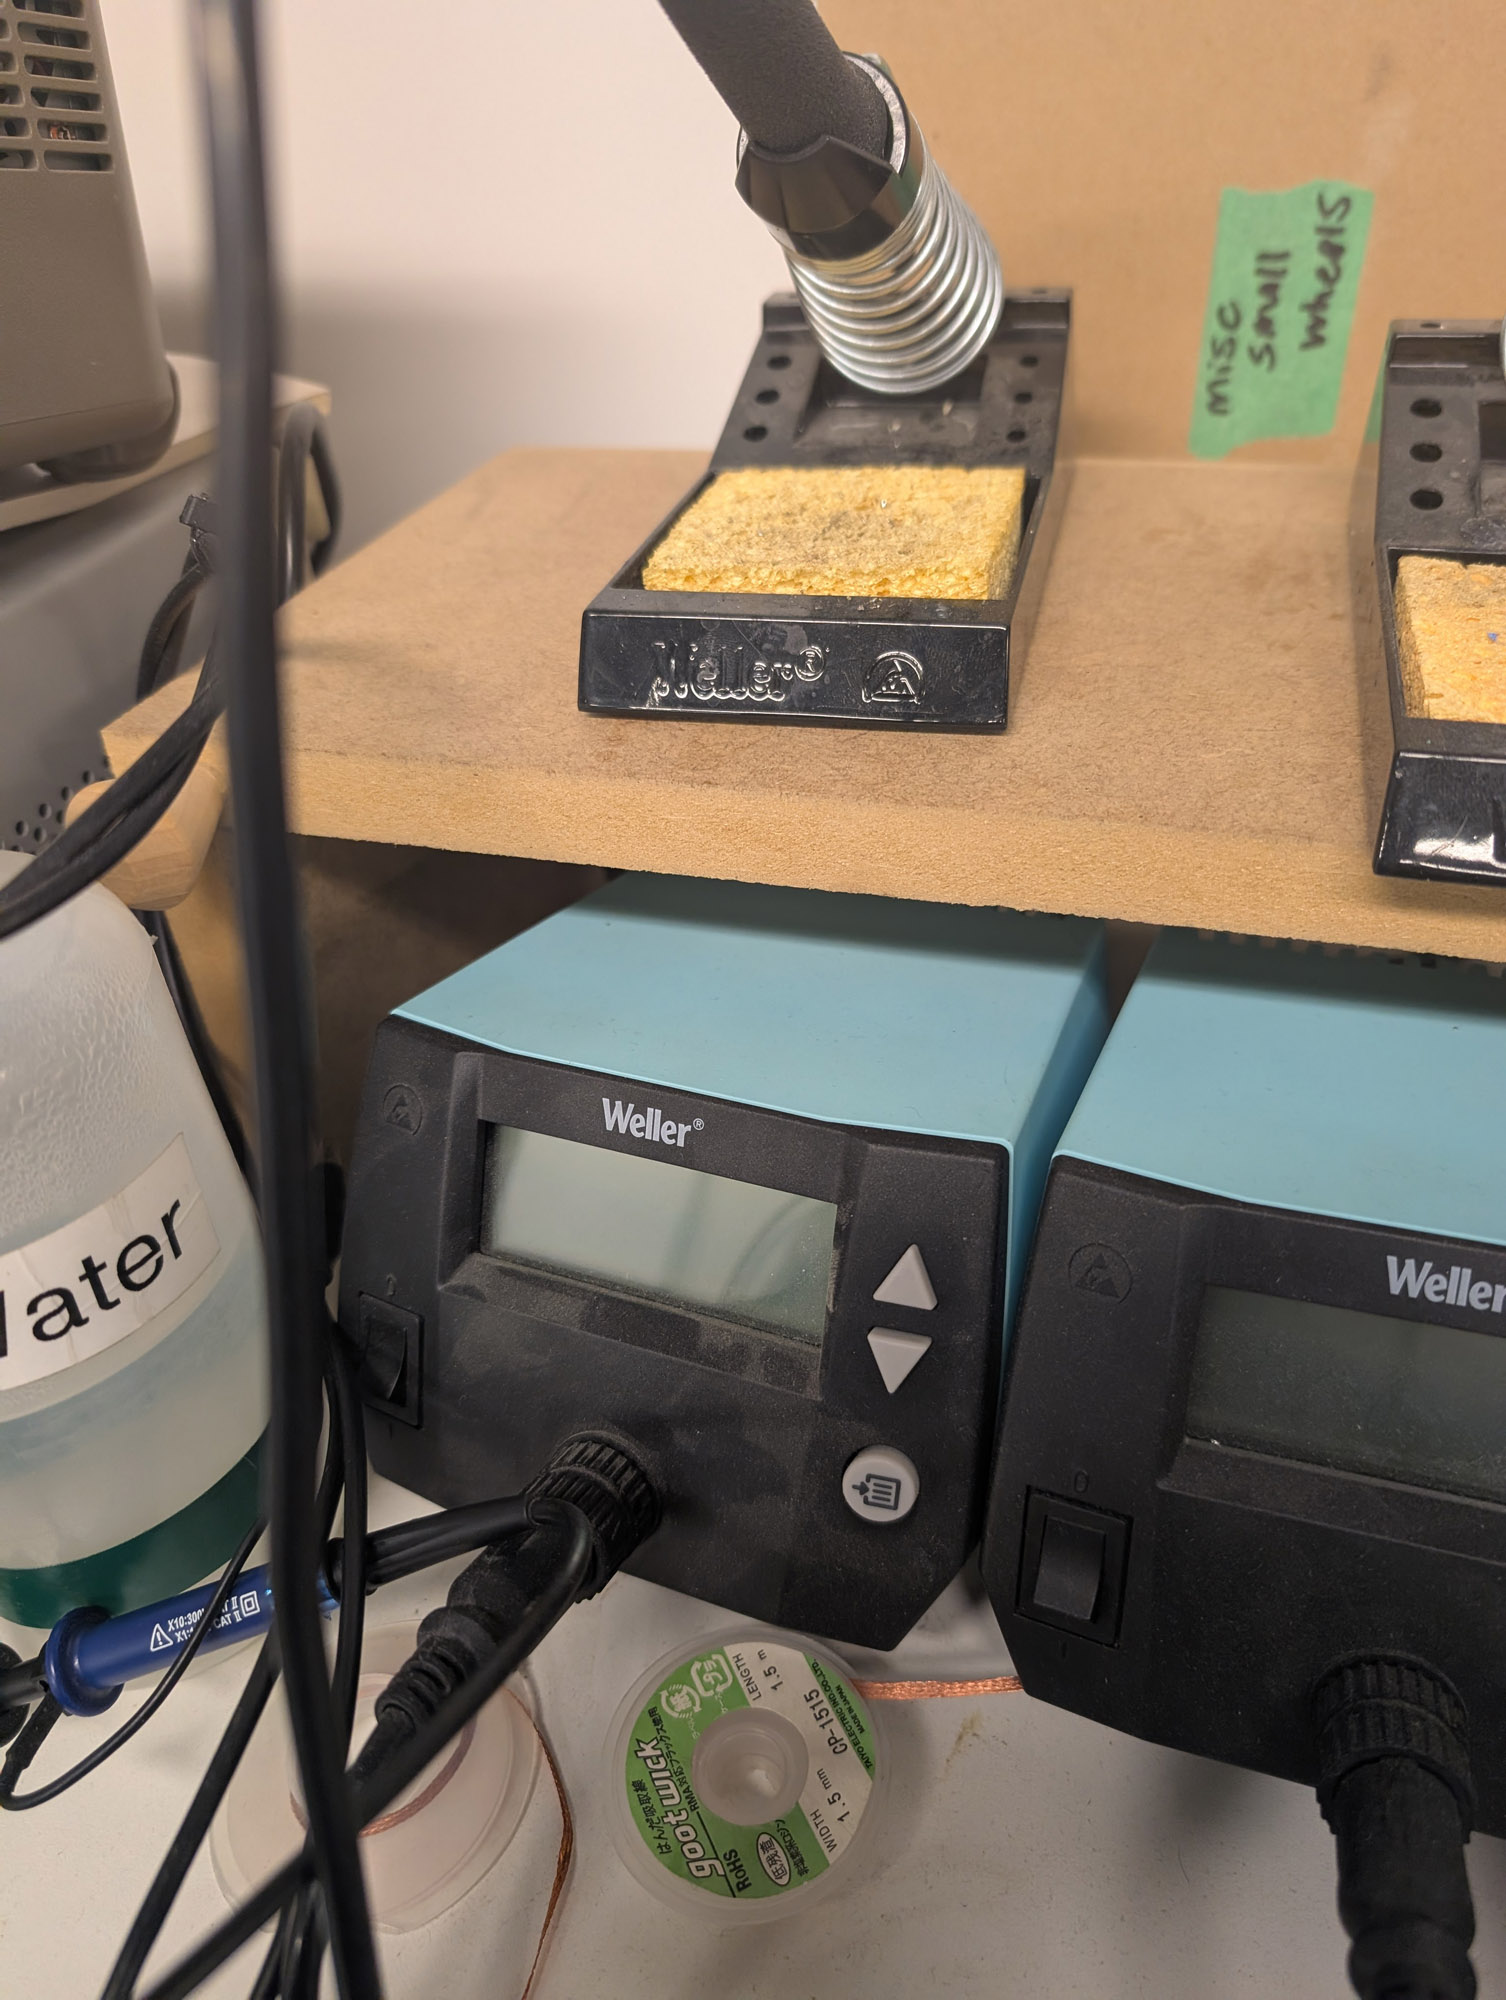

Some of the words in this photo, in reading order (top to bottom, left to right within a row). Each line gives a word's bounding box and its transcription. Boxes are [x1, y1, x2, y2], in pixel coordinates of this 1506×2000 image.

[1248, 250, 1290, 372] small
[0, 1199, 182, 1359] ater
[1386, 1255, 1506, 1313] Weller
[757, 1649, 767, 1660] m
[732, 1652, 762, 1701] LENGTH
[763, 1665, 783, 1691] 1.5
[835, 1684, 851, 1705] JAPAN
[803, 1688, 848, 1755] CP-1515
[836, 1706, 861, 1745] ELECTRIC
[846, 1704, 855, 1714] IN
[850, 1713, 865, 1734] MADE
[634, 1736, 683, 1808] wick
[856, 1745, 873, 1769] TAIYO
[816, 1768, 832, 1790] mm
[827, 1791, 851, 1822] 1.5
[661, 1807, 727, 1879] goot
[810, 1808, 838, 1853] WIDTH
[723, 1848, 752, 1892] RoHS
